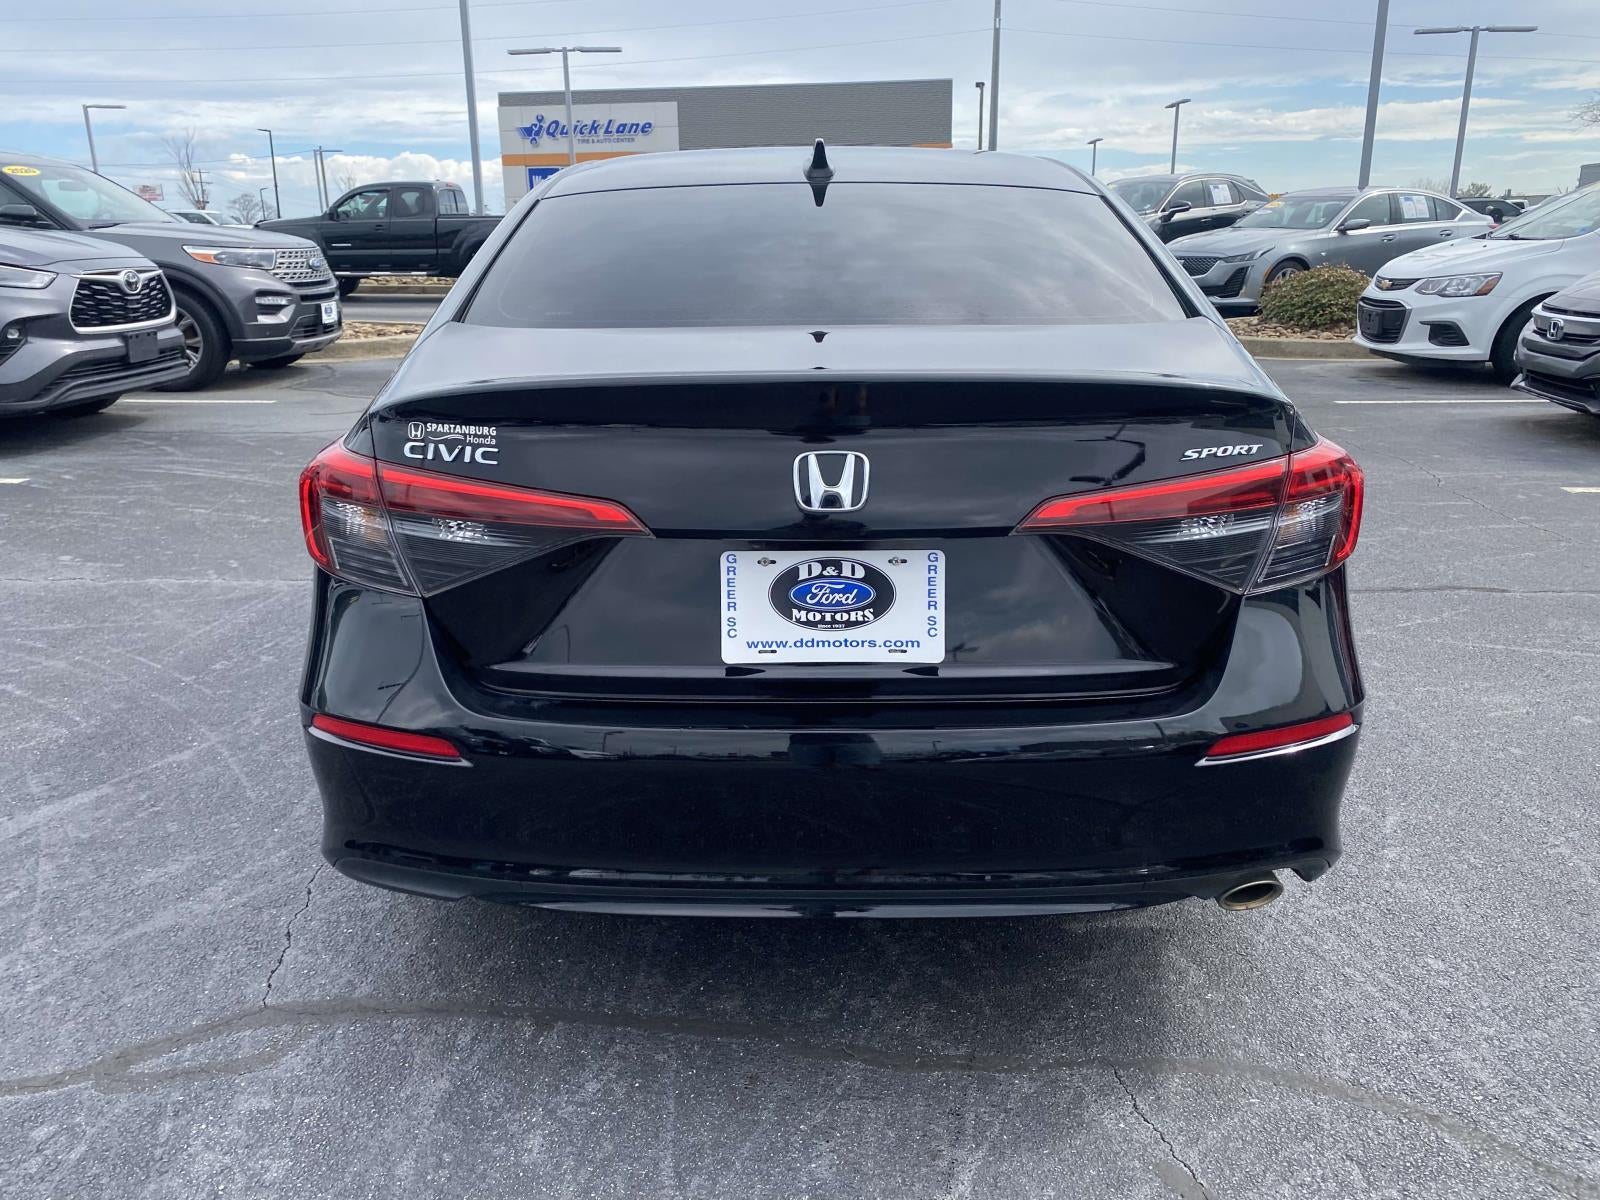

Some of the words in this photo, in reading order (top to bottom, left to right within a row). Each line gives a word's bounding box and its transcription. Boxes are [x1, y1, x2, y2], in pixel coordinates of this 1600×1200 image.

[545, 119, 601, 137] Quick
[603, 119, 653, 136] Lane
[426, 422, 497, 436] SPARTANBURG
[466, 434, 496, 445] Honda
[403, 441, 499, 465] CIVIC
[1180, 444, 1264, 461] SPORT
[797, 560, 866, 581] D&D
[726, 553, 738, 612] GREER
[927, 552, 939, 611] GREER
[806, 583, 858, 605] Ford
[791, 608, 875, 622] MOTORS
[726, 616, 738, 639] SC
[927, 615, 939, 638] SC
[746, 638, 921, 649] www.ddmotors.com
